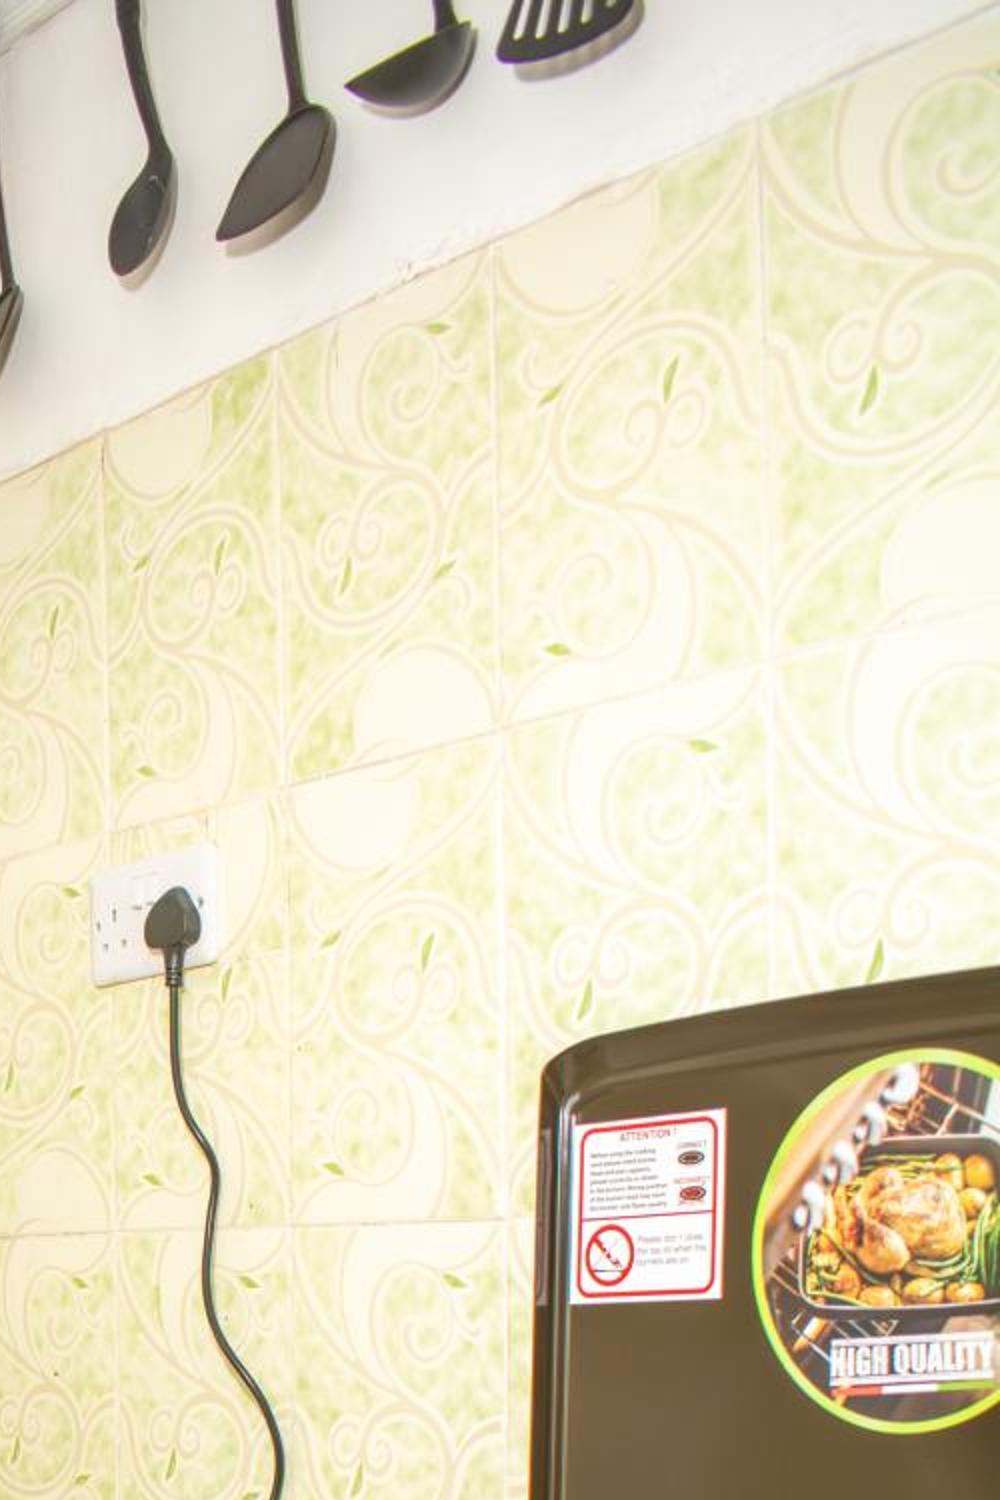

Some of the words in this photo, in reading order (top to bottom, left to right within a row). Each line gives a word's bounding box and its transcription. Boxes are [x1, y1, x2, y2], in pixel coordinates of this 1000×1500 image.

[620, 1129, 671, 1141] ATTENTION
[831, 1345, 889, 1377] HIGH
[893, 1339, 994, 1374] QUALITY
